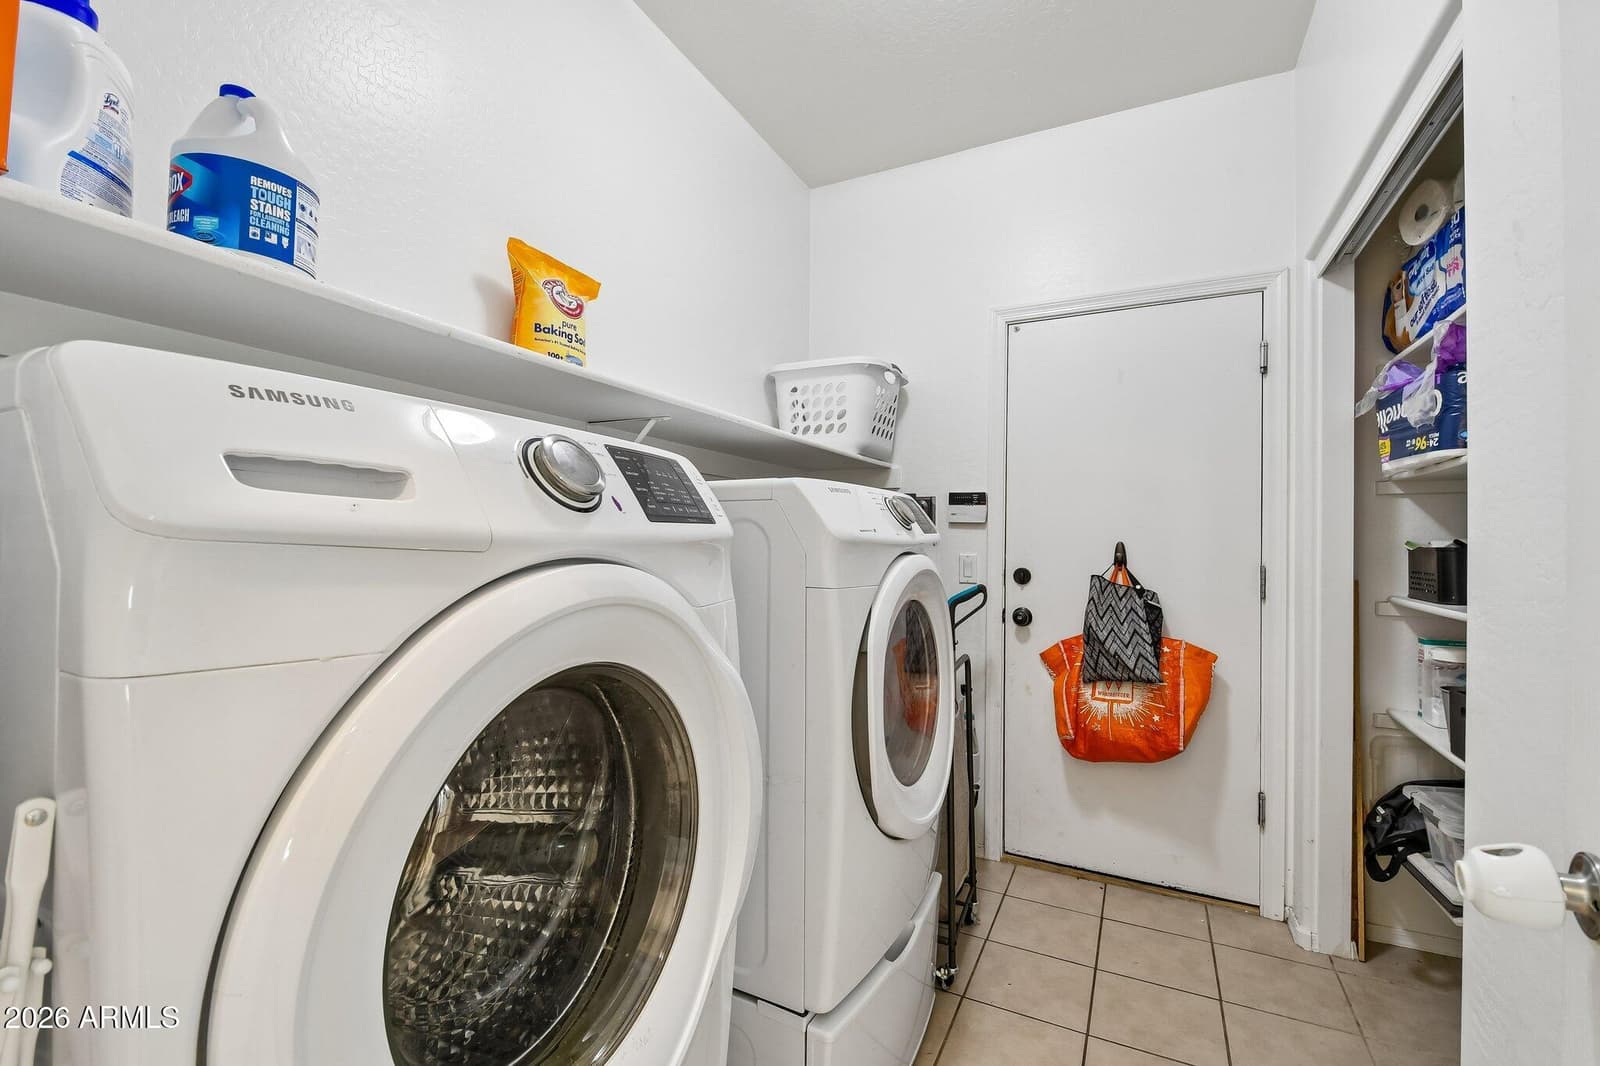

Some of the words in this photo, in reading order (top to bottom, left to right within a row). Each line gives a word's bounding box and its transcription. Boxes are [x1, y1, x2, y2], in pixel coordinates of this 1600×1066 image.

[250, 175, 293, 199] REMOVES
[250, 185, 292, 211] TOUGH
[249, 198, 291, 222] STAINS
[249, 216, 290, 237] CLEANING
[534, 322, 573, 344] Baking
[562, 321, 577, 332] pure
[228, 384, 356, 413] SAMSUNG
